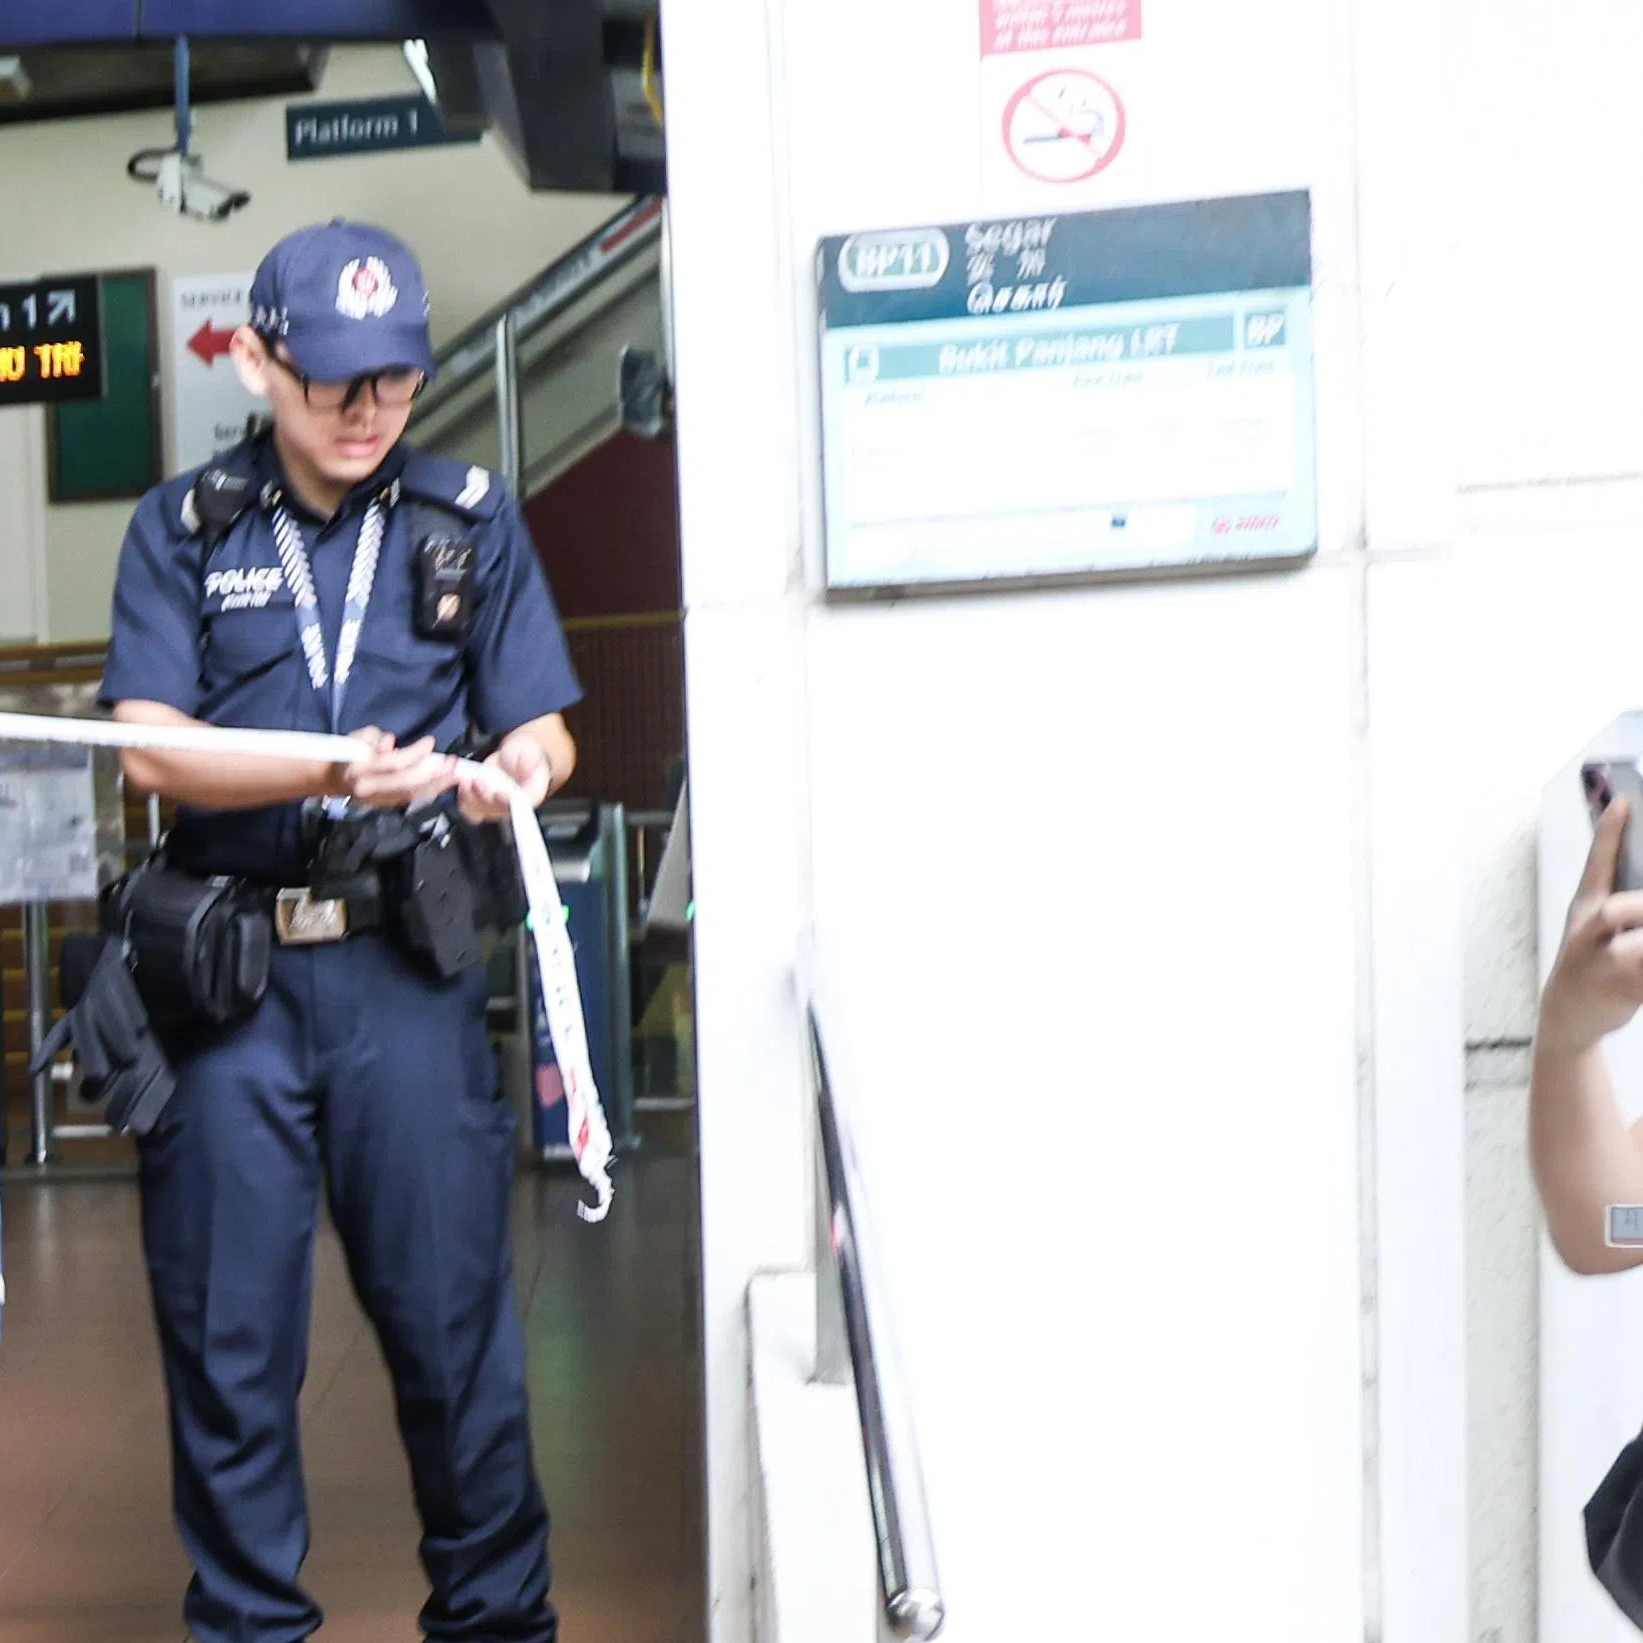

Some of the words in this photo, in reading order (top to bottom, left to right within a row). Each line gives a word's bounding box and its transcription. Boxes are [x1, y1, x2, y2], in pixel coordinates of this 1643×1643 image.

[295, 113, 399, 147] Platform
[409, 106, 419, 137] 1
[21, 293, 37, 330] 1
